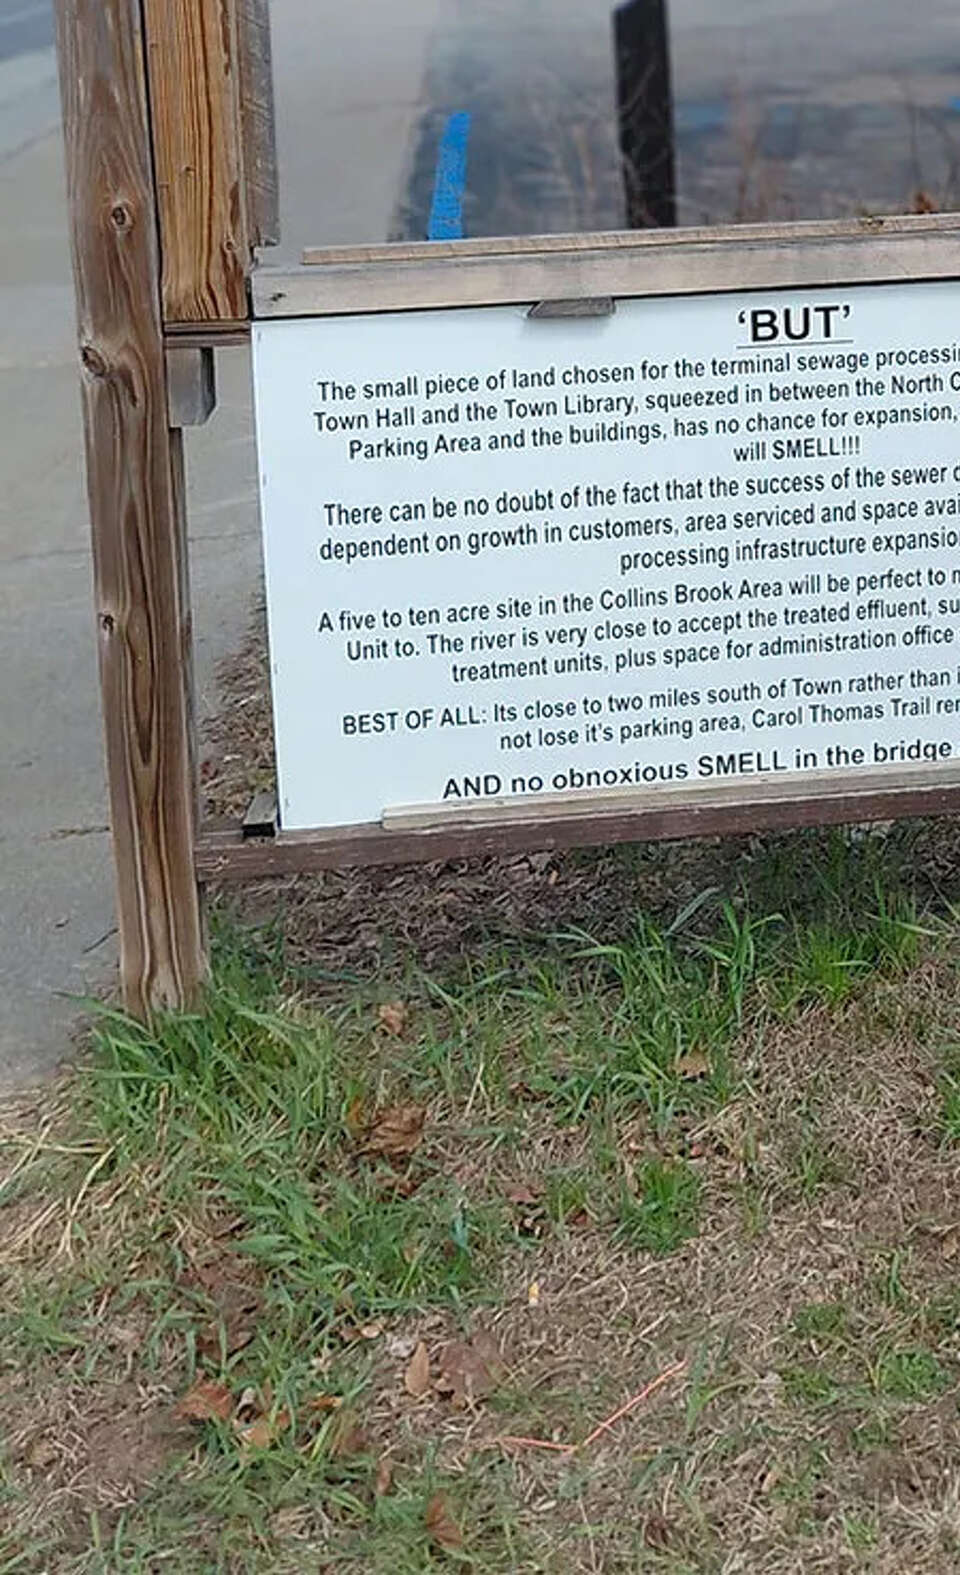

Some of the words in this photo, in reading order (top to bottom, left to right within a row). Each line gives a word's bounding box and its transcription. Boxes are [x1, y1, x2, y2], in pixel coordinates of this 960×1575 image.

[312, 411, 369, 431] Town
[375, 405, 415, 427] Hall
[421, 403, 459, 425] and
[465, 401, 498, 421] the
[503, 398, 557, 418] Town
[644, 385, 738, 412] squeezed
[745, 383, 762, 403] in
[768, 382, 850, 401] between
[854, 376, 886, 396] the
[890, 373, 944, 394] North
[316, 380, 356, 401] The
[362, 375, 418, 399] small
[425, 374, 480, 399] piece
[485, 368, 506, 391] of
[512, 366, 555, 388] land
[561, 365, 634, 385] chosen
[640, 359, 669, 380] for
[673, 358, 705, 378] the
[710, 352, 790, 376] terminal
[796, 352, 869, 373] sewage
[348, 437, 428, 460] Parking
[433, 433, 481, 453] Area
[487, 428, 525, 450] and
[530, 426, 563, 446] the
[670, 417, 708, 436] has
[714, 418, 740, 434] no
[745, 412, 816, 432] chance
[820, 407, 848, 427] for
[732, 441, 766, 461] will
[319, 532, 430, 562] dependent
[434, 533, 464, 551] on
[466, 523, 538, 555] growth
[544, 521, 562, 543] in
[684, 513, 726, 532] area
[732, 503, 815, 529] serviced
[820, 499, 856, 523] and
[862, 501, 918, 524] space
[620, 543, 729, 574] processing
[735, 536, 866, 560] infrastructure
[500, 730, 532, 749] not
[537, 728, 579, 746] lose
[620, 717, 693, 743] parking
[752, 706, 802, 728] Carol
[808, 703, 884, 722] Thomas
[890, 695, 930, 716] Trail
[442, 774, 502, 798] AND
[511, 775, 544, 792] no
[551, 762, 689, 789] obnoxious
[697, 750, 788, 778] SMELL
[795, 748, 820, 771] in
[825, 745, 864, 769] the
[869, 739, 954, 767] bridge
